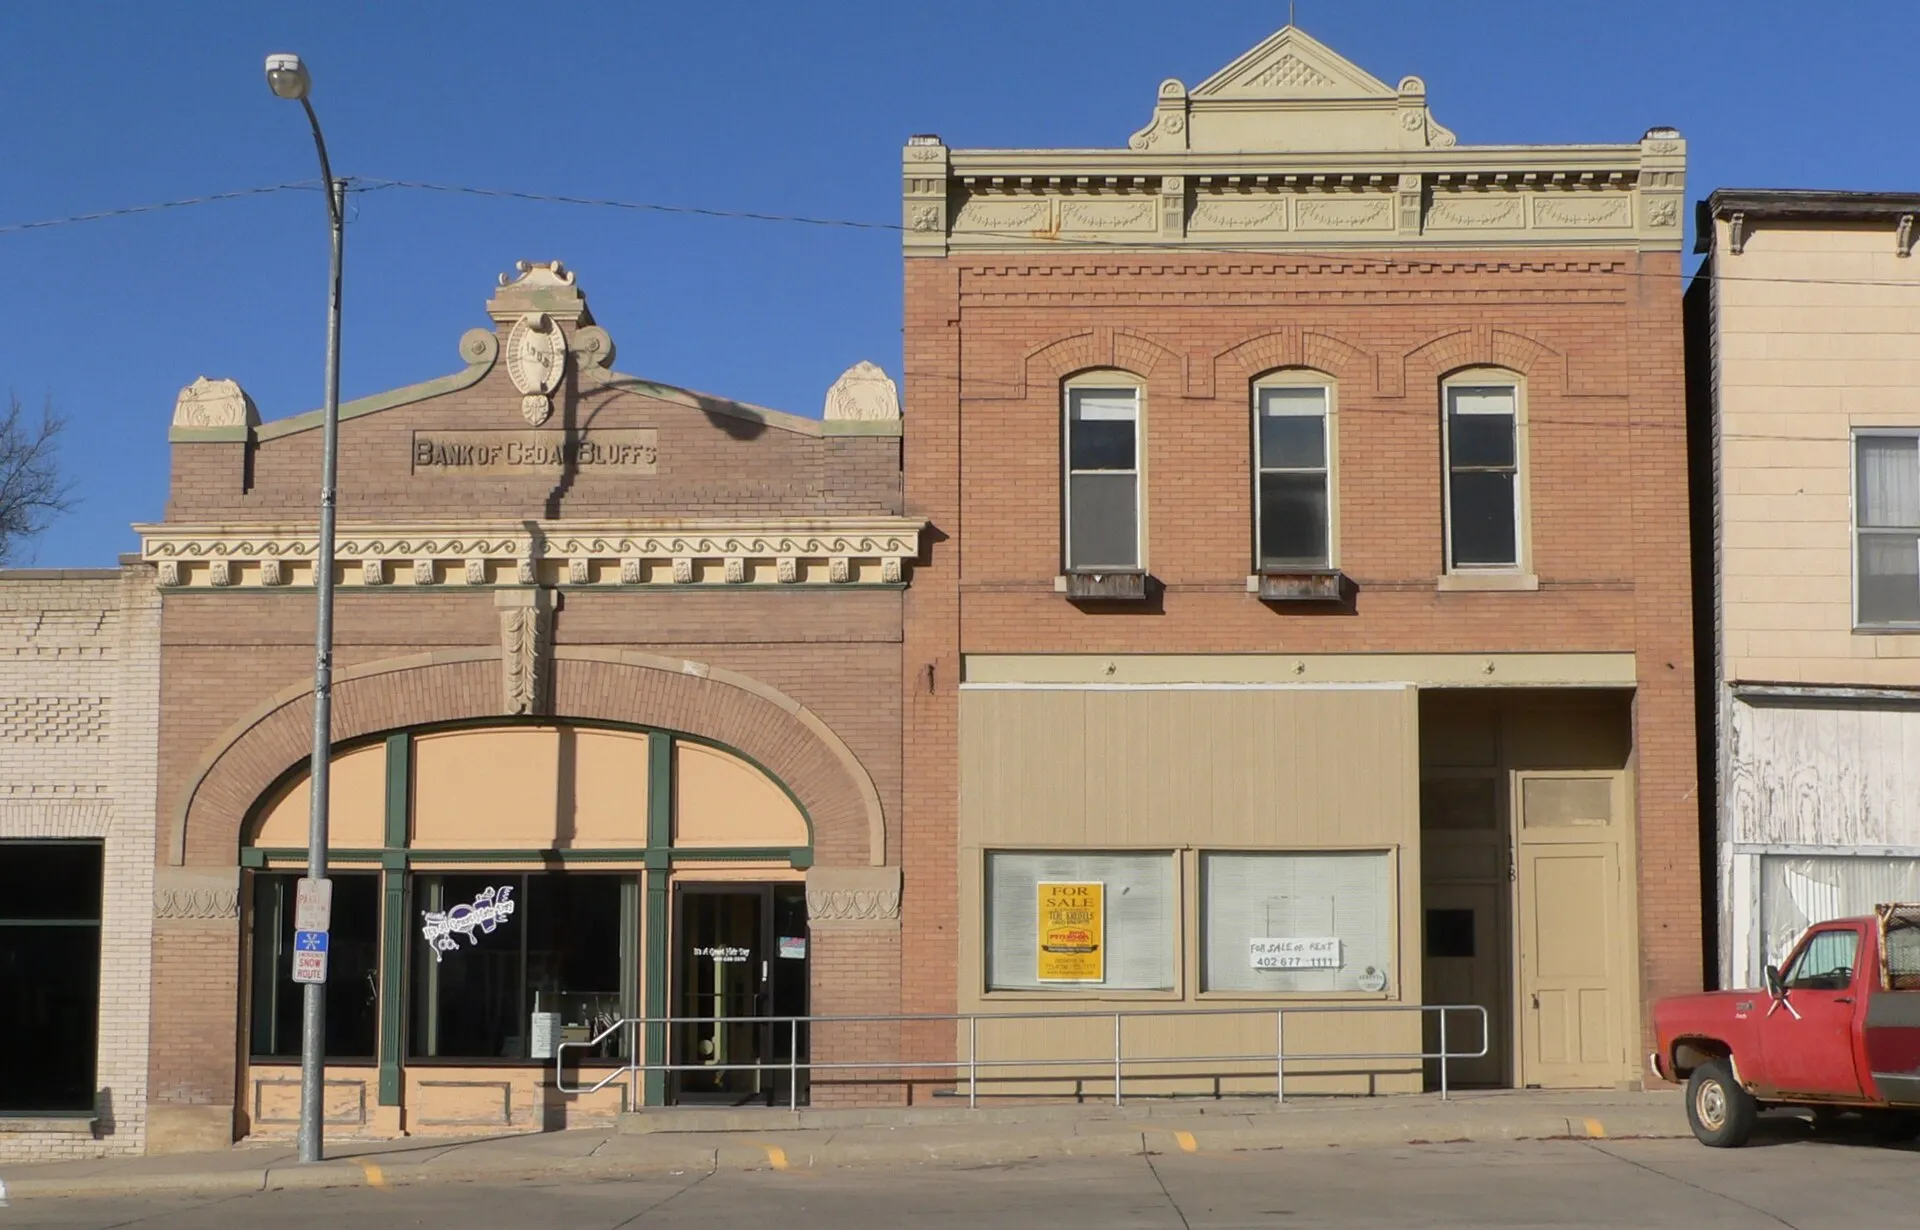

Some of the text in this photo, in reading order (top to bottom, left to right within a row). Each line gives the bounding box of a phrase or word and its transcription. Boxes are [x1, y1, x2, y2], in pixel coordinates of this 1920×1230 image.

[415, 440, 657, 466] BANK OF CEDA BLUFFS
[1052, 887, 1088, 896] FOR
[1046, 898, 1095, 907] SALE
[1250, 944, 1265, 954] FOR
[1267, 942, 1293, 953] SALE
[1309, 942, 1334, 951] RENT
[299, 958, 321, 968] SNOW
[1257, 957, 1277, 966] 402
[1280, 957, 1301, 966] 677
[297, 969, 321, 979] ROUTE
